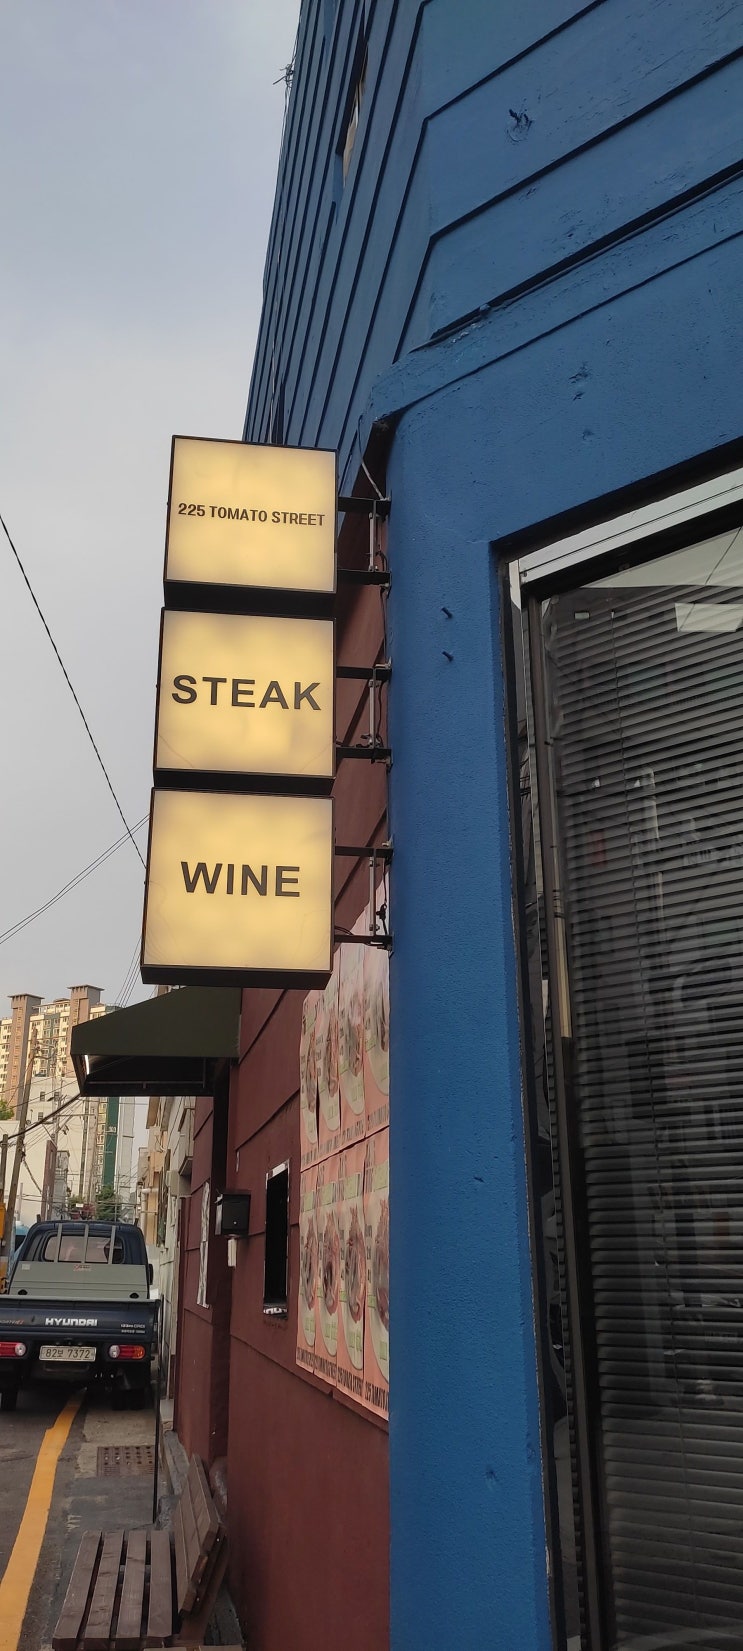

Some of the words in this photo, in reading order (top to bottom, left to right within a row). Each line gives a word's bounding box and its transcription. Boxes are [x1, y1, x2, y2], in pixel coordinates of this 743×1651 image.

[178, 503, 206, 517] 225
[209, 505, 268, 523] TOMATO
[271, 511, 326, 526] STREET
[171, 674, 322, 711] STEAK
[180, 861, 301, 898] WINE
[45, 1318, 98, 1326] HYUNDAI
[68, 1349, 91, 1359] 7372
